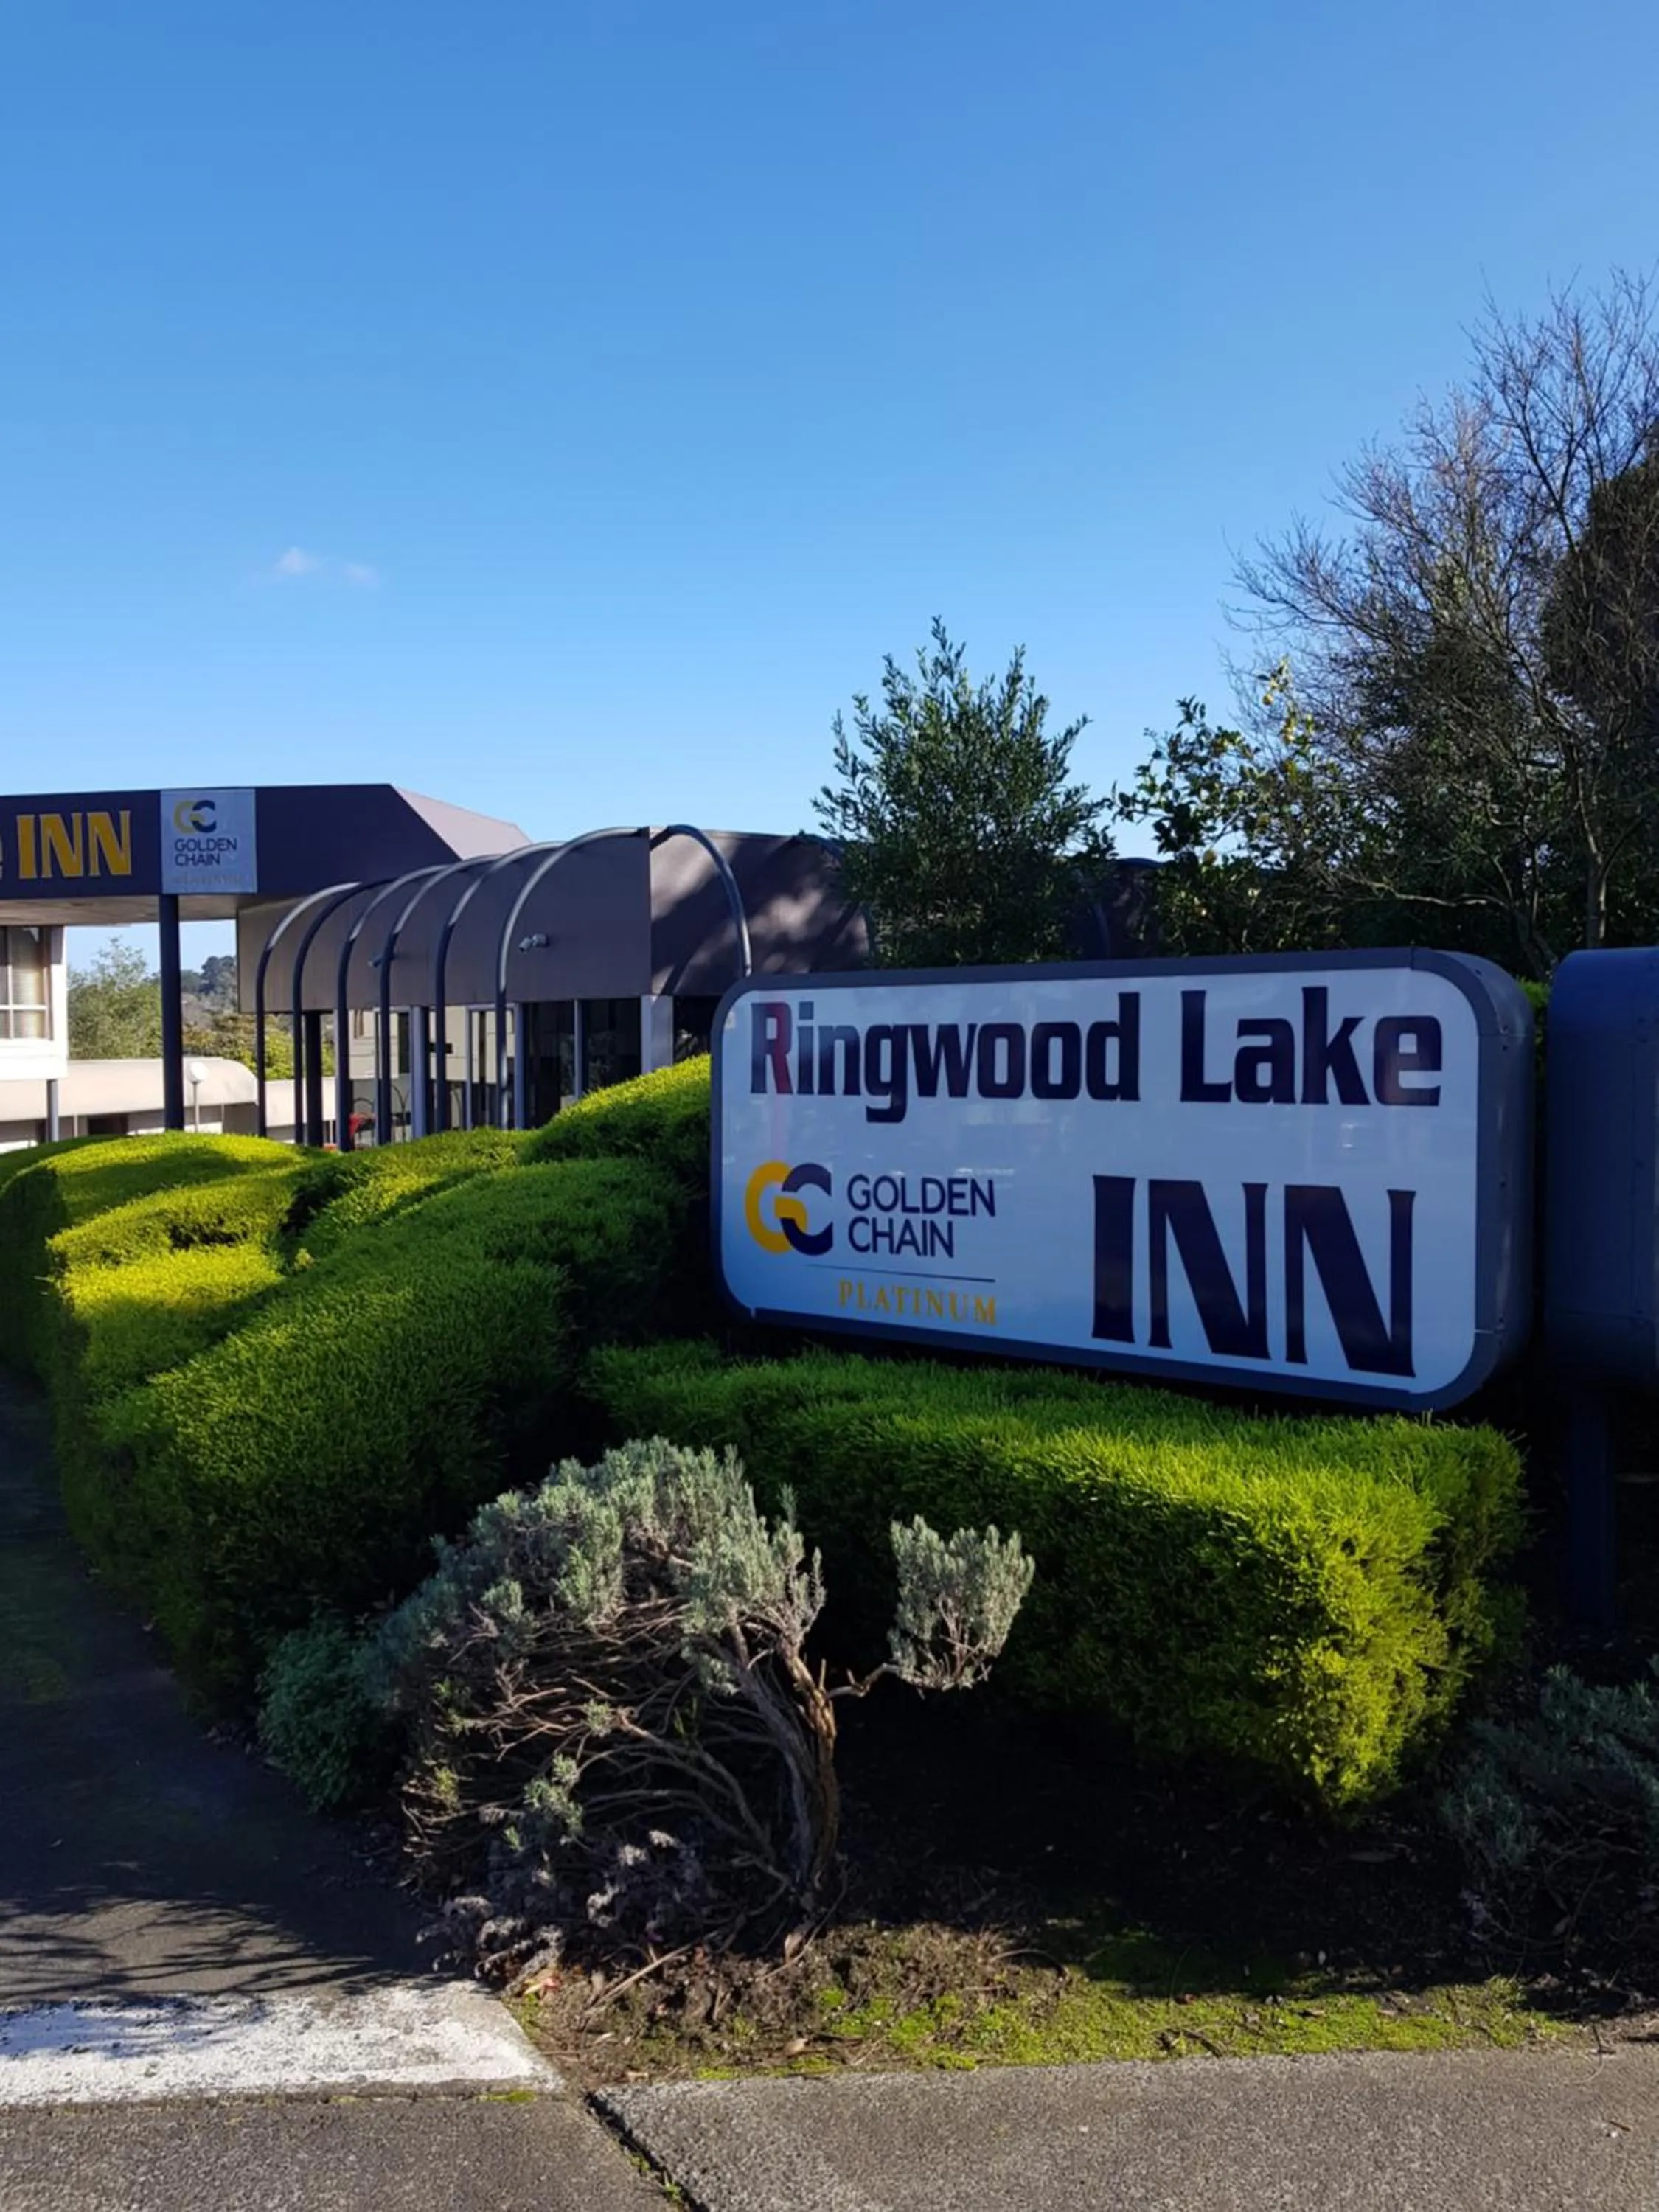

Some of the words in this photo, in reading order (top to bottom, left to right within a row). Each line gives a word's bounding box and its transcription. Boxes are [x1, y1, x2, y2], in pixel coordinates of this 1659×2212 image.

[16, 810, 131, 879] INN
[174, 838, 237, 852] GOLDEN
[175, 853, 220, 866] CHAIN
[750, 992, 1141, 1123] Ringwood
[1180, 987, 1442, 1106] Lake
[847, 1174, 996, 1217] GOLDEN
[848, 1216, 954, 1258] CHAIN
[1092, 1175, 1416, 1377] INN
[838, 1277, 998, 1326] PLATINUM
